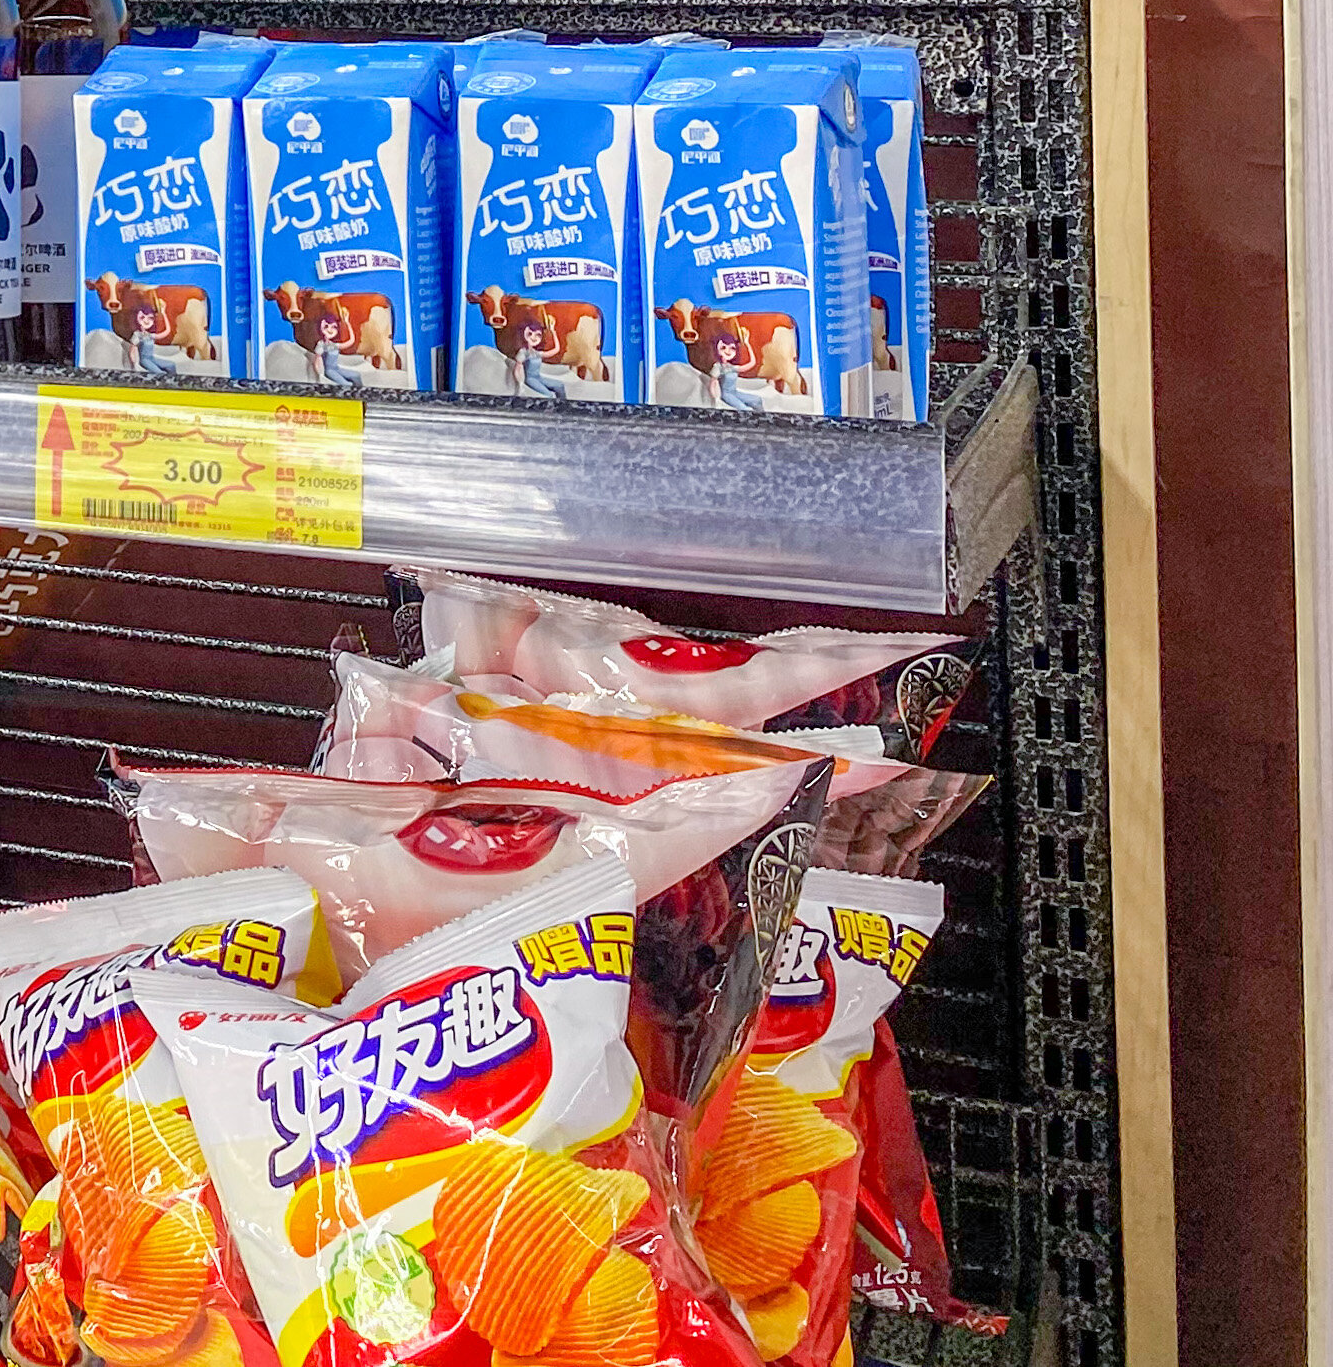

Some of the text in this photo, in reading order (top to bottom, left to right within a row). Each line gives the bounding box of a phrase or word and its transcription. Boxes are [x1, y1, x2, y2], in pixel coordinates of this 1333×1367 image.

[93, 155, 202, 227] 巧恋
[269, 158, 382, 235] 巧恋
[477, 163, 598, 238] 巧恋
[660, 169, 786, 250] 巧恋
[119, 213, 189, 244] 原味酸奶
[297, 217, 370, 251] 原味酸奶
[506, 224, 583, 256] 原味酸奶
[144, 248, 186, 267] 原装进口
[324, 253, 367, 274] 原装进口
[692, 233, 773, 267] 原味酸奶
[532, 261, 579, 280] 原装进口
[722, 271, 771, 292] 原装进口
[163, 458, 223, 485] 3.00
[168, 920, 286, 986] 赠品
[515, 912, 634, 982] 赠品
[831, 907, 935, 985] 赠品
[216, 1009, 310, 1026] 好丽友
[265, 967, 534, 1183] 好友趣
